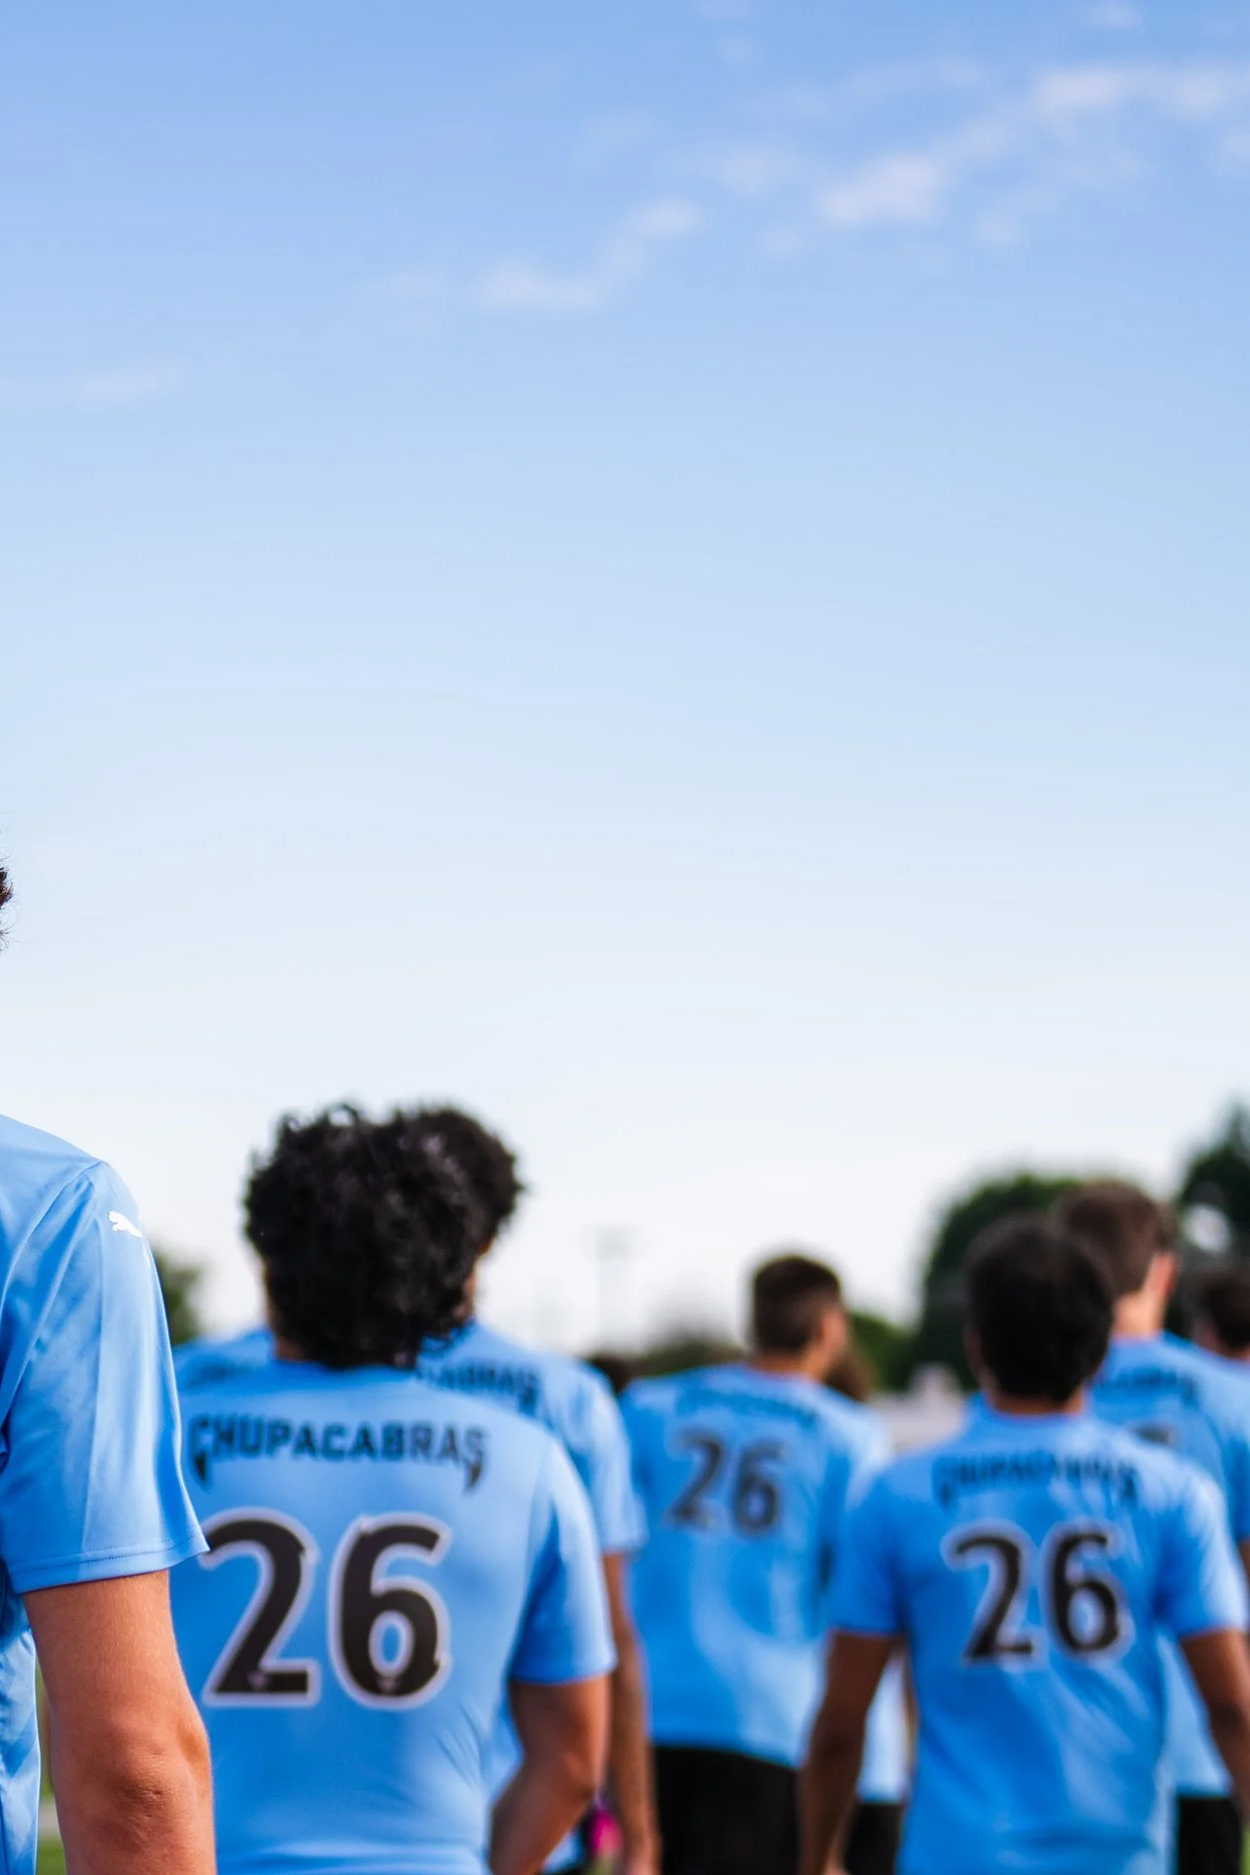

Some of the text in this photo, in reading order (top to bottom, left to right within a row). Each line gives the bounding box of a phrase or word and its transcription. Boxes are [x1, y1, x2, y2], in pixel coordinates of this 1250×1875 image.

[189, 1413, 487, 1494] CHUPACABRAS
[664, 1424, 790, 1540] 26
[200, 1510, 450, 1707] 26
[941, 1521, 1136, 1670] 26
